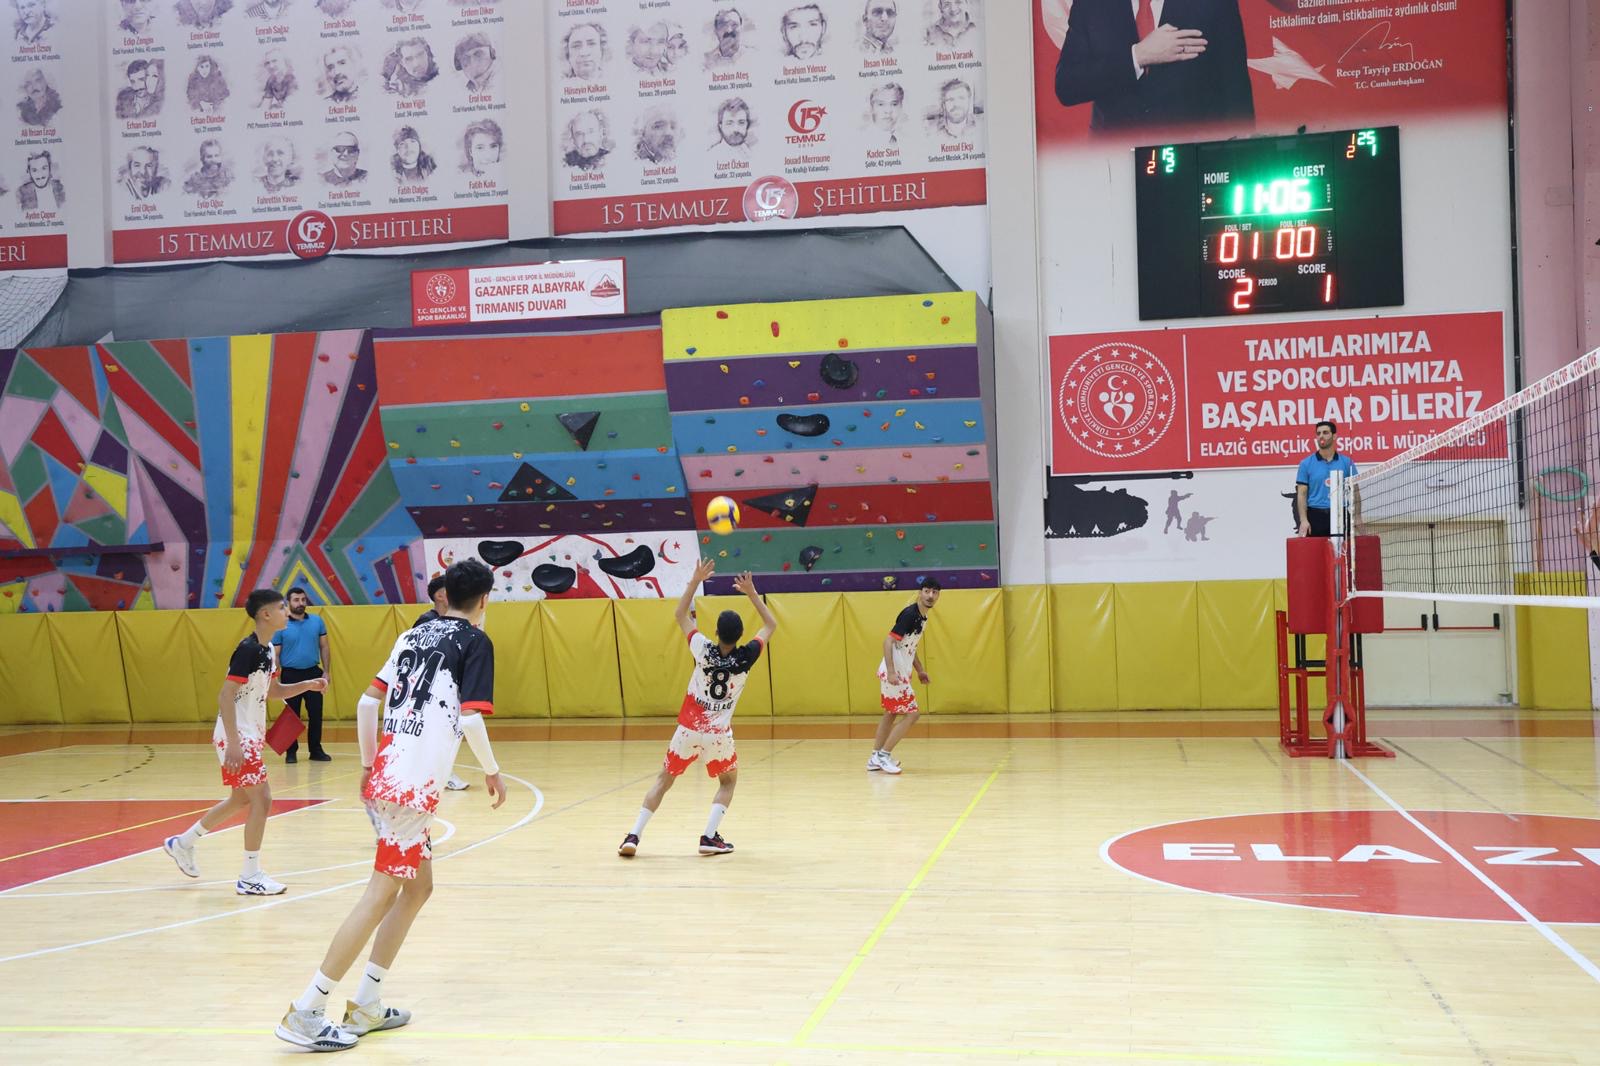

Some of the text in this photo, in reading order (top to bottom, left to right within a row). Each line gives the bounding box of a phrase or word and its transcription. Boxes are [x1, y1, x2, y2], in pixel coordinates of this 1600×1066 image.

[1269, 0, 1457, 29] İstiklalimiz daim, istikbalimiz aydınlık olsun!
[1336, 58, 1443, 78] Recep Tayyip ERDOĞAN
[1370, 76, 1425, 89] Cumhurbaşkanı
[785, 133, 826, 144] TEMMUZ
[1357, 130, 1376, 145] 25
[866, 149, 885, 159] Kader
[1162, 147, 1175, 161] 15
[1346, 145, 1355, 159] 2
[1147, 161, 1156, 174] 2
[1293, 165, 1325, 177] GUEST
[1204, 172, 1230, 184] HOME
[601, 178, 926, 225] 15 TEMMUZ ŞEHİTLERİ
[754, 208, 785, 217] TEMMUZ
[158, 213, 452, 254] 15 TEMMUZ ŞEHİTLERİ
[1224, 224, 1238, 232] FOUL
[1242, 223, 1252, 231] SET
[296, 242, 325, 250] TEMMUZ
[1276, 226, 1316, 259] 00
[1218, 268, 1246, 280] SCORE
[1297, 263, 1326, 274] SCORE
[525, 273, 537, 281] SPOR
[1258, 278, 1278, 287] PERIOD
[475, 283, 529, 298] GAZANFER
[531, 280, 585, 295] ALBAYRAK
[1233, 277, 1253, 310] 2
[1323, 273, 1332, 302] 1
[429, 306, 457, 314] GENÇLİK
[475, 298, 567, 315] TIRMANIŞ DUVARI
[434, 313, 467, 321] BAKANLIĞI
[1244, 330, 1432, 362] TAKIMLARIMIZA
[1217, 360, 1463, 393] VE SPORCULARIMIZA
[1080, 363, 1155, 436] TÜRKİYE CUMHURİYETİ GENÇLİK VE SPOR BAKANLIĞI
[1202, 393, 1364, 432] BAŞARILAR
[1370, 386, 1483, 421] DİLERİZ
[1200, 437, 1248, 457] ELAZIĞ
[1252, 435, 1309, 459] GENÇLİK
[1336, 436, 1373, 454] SPOR
[1377, 432, 1390, 450] İL
[389, 649, 445, 712] 34
[709, 668, 730, 700] 8
